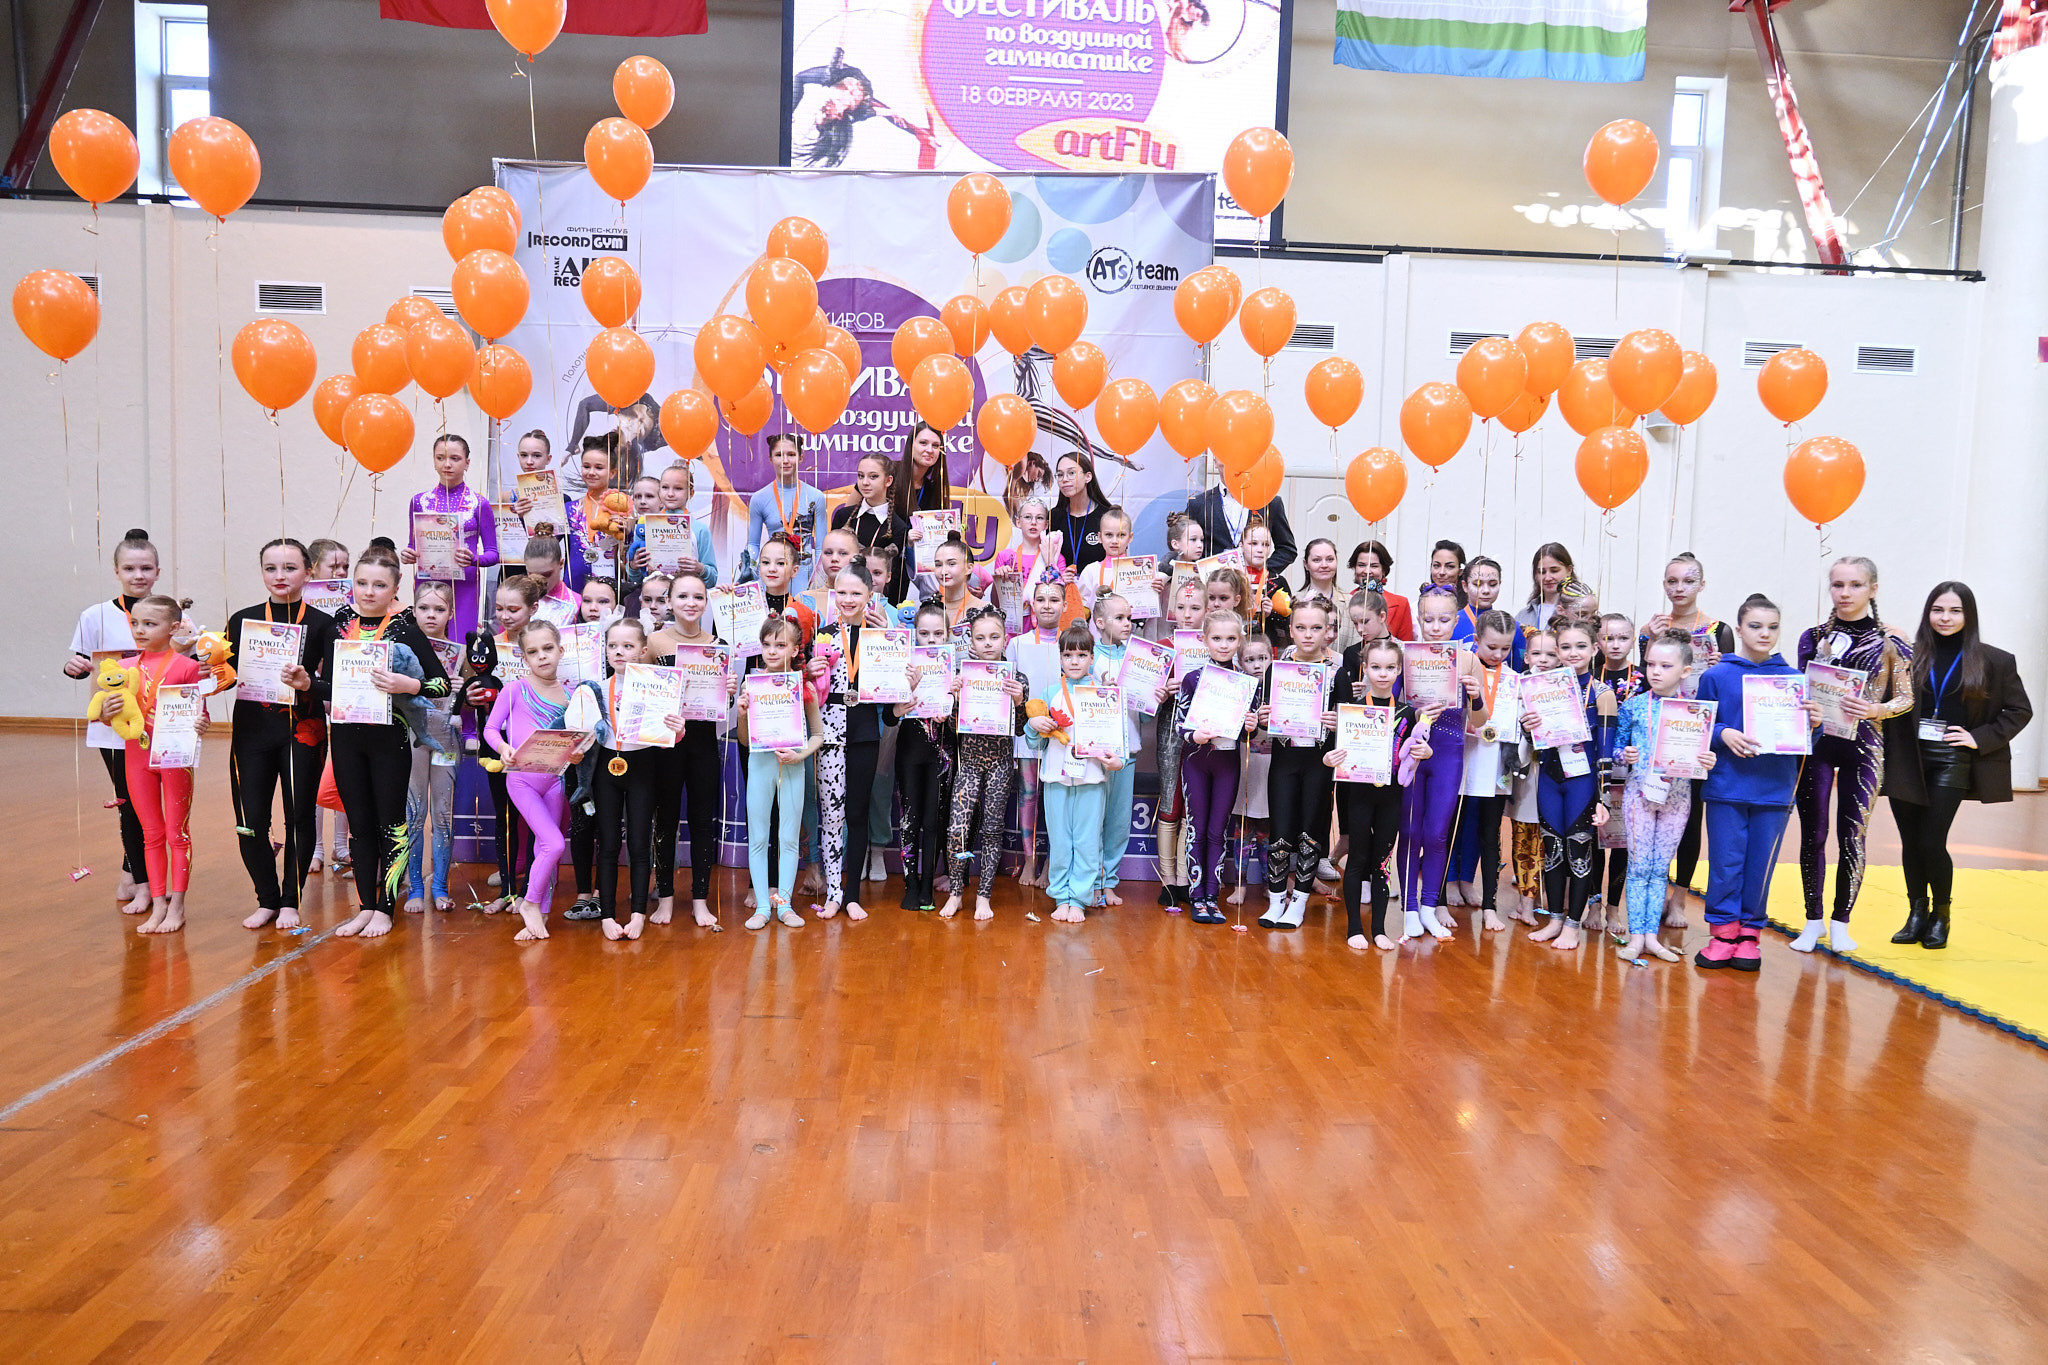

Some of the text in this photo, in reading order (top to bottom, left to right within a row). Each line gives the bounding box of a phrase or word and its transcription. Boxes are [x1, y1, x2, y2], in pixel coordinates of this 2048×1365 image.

[942, 0, 1155, 24] ФЕСТИВАЛЬ
[986, 22, 1153, 50] по воздушной
[985, 48, 1155, 73] гимнастике
[960, 85, 1135, 111] 18 ФЕВРАЛЯ 2023
[533, 234, 624, 249] RECORD GYM
[1136, 260, 1179, 281] team
[554, 277, 581, 287] REC
[825, 312, 885, 329] ИРОВ
[532, 492, 538, 501] 2
[503, 522, 509, 532] 2
[660, 534, 665, 543] 2
[1127, 577, 1132, 586] 3
[736, 604, 761, 614] МЕСТО
[248, 638, 285, 649] ГРАМОТА
[257, 647, 264, 658] 3
[265, 647, 295, 657] МЕСТО
[341, 659, 375, 667] ГРАМОТА
[350, 667, 354, 678] 1
[499, 667, 506, 678] 3
[966, 679, 1002, 687] ДИПЛОМ
[1277, 680, 1314, 689] ДИПЛОМ
[753, 692, 791, 702] ДИПЛОМ
[169, 711, 175, 722] 2
[1089, 708, 1094, 719] 3
[1345, 721, 1378, 730] ГРАМОТА
[1664, 719, 1702, 729] ДИПЛОМ
[1353, 729, 1360, 740] 2
[1361, 729, 1386, 737] МЕСТО
[1671, 726, 1705, 734] УЧАСТНИКА
[1132, 802, 1150, 830] 3
